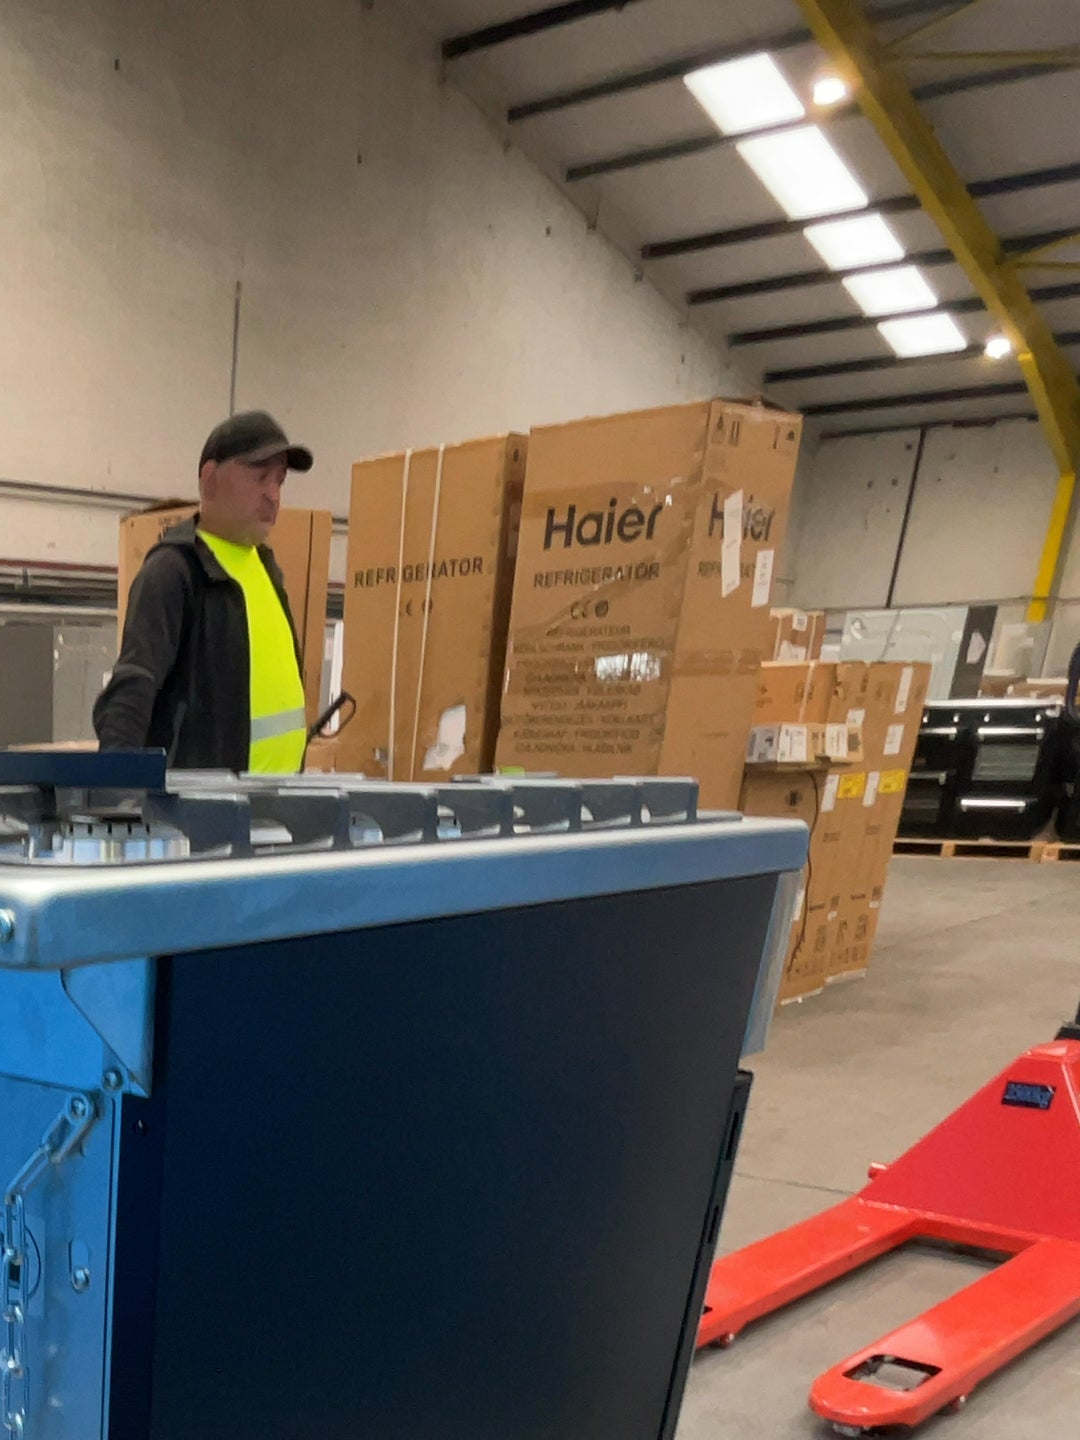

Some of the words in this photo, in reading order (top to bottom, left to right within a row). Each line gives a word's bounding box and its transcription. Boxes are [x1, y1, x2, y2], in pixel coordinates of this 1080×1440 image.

[543, 498, 664, 550] Haier
[708, 491, 775, 542] Hier
[354, 556, 483, 588] REFRGERATOR
[533, 562, 660, 588] REFRIGERATOR
